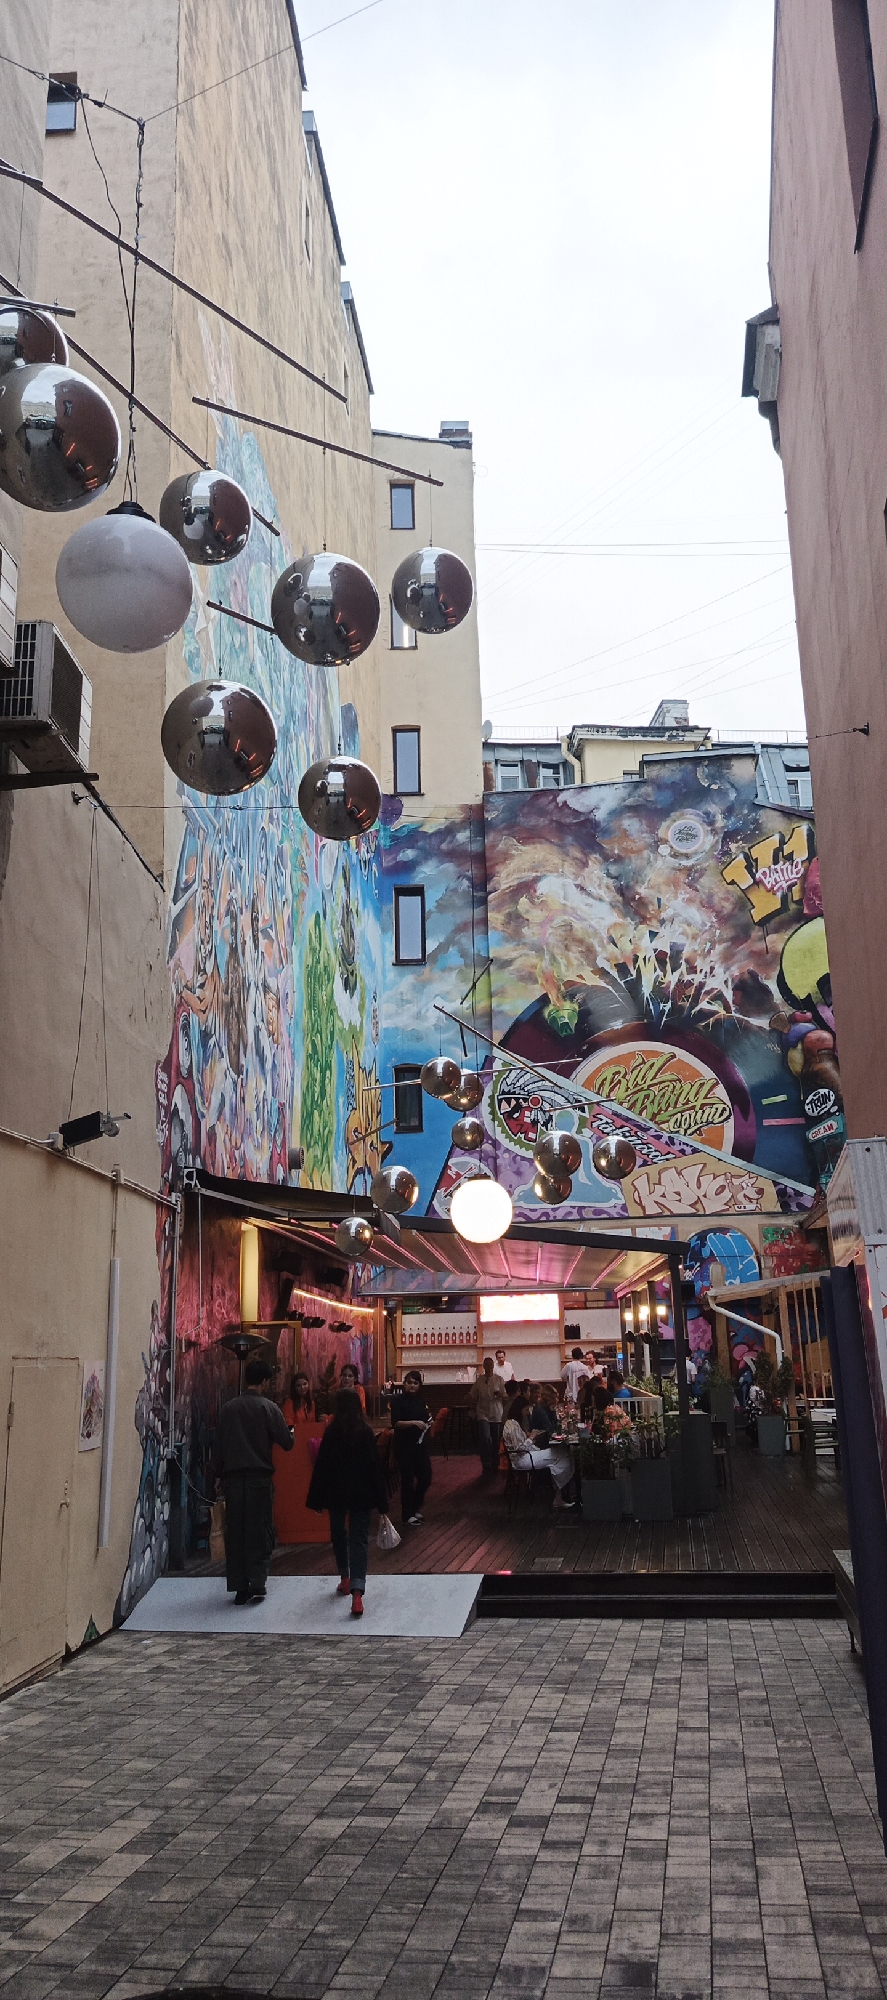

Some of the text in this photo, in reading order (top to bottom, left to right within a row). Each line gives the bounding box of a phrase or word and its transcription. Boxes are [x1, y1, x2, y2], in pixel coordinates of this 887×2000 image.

[755, 857, 805, 890] BATTLE
[594, 1051, 682, 1103] Big
[628, 1077, 726, 1126] Bang
[810, 1123, 835, 1140] CREAM
